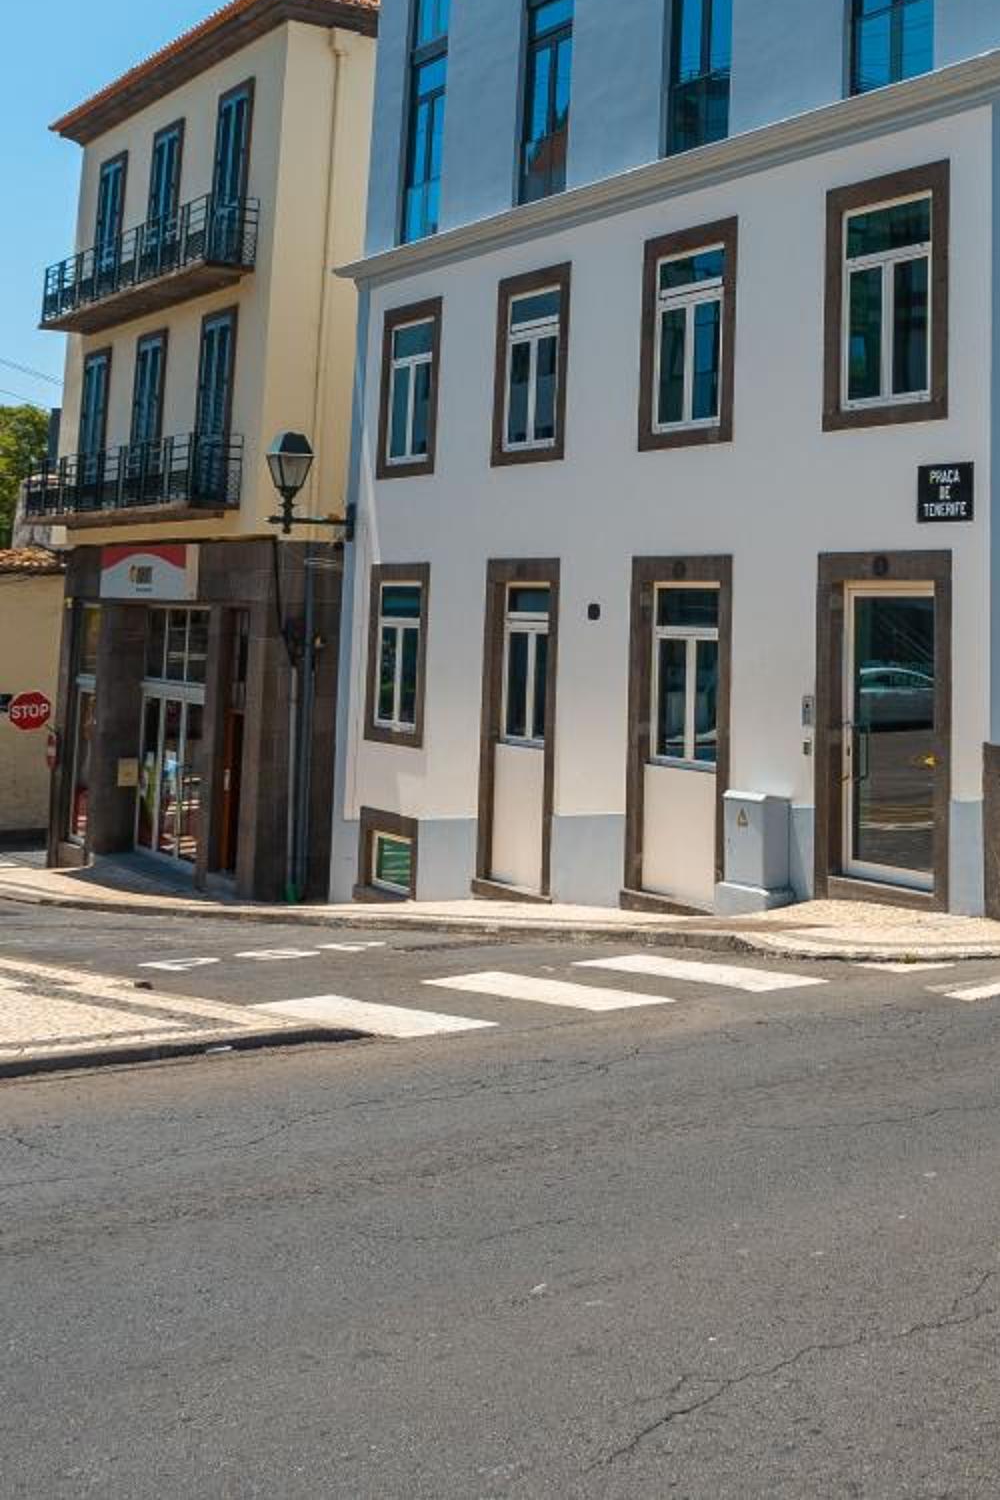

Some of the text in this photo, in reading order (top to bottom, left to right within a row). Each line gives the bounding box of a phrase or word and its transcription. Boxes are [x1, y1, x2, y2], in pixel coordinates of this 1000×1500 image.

[929, 469, 961, 485] PRAÇA
[939, 485, 951, 500] DE
[923, 501, 967, 517] TENERIFE
[11, 703, 49, 719] STOP
